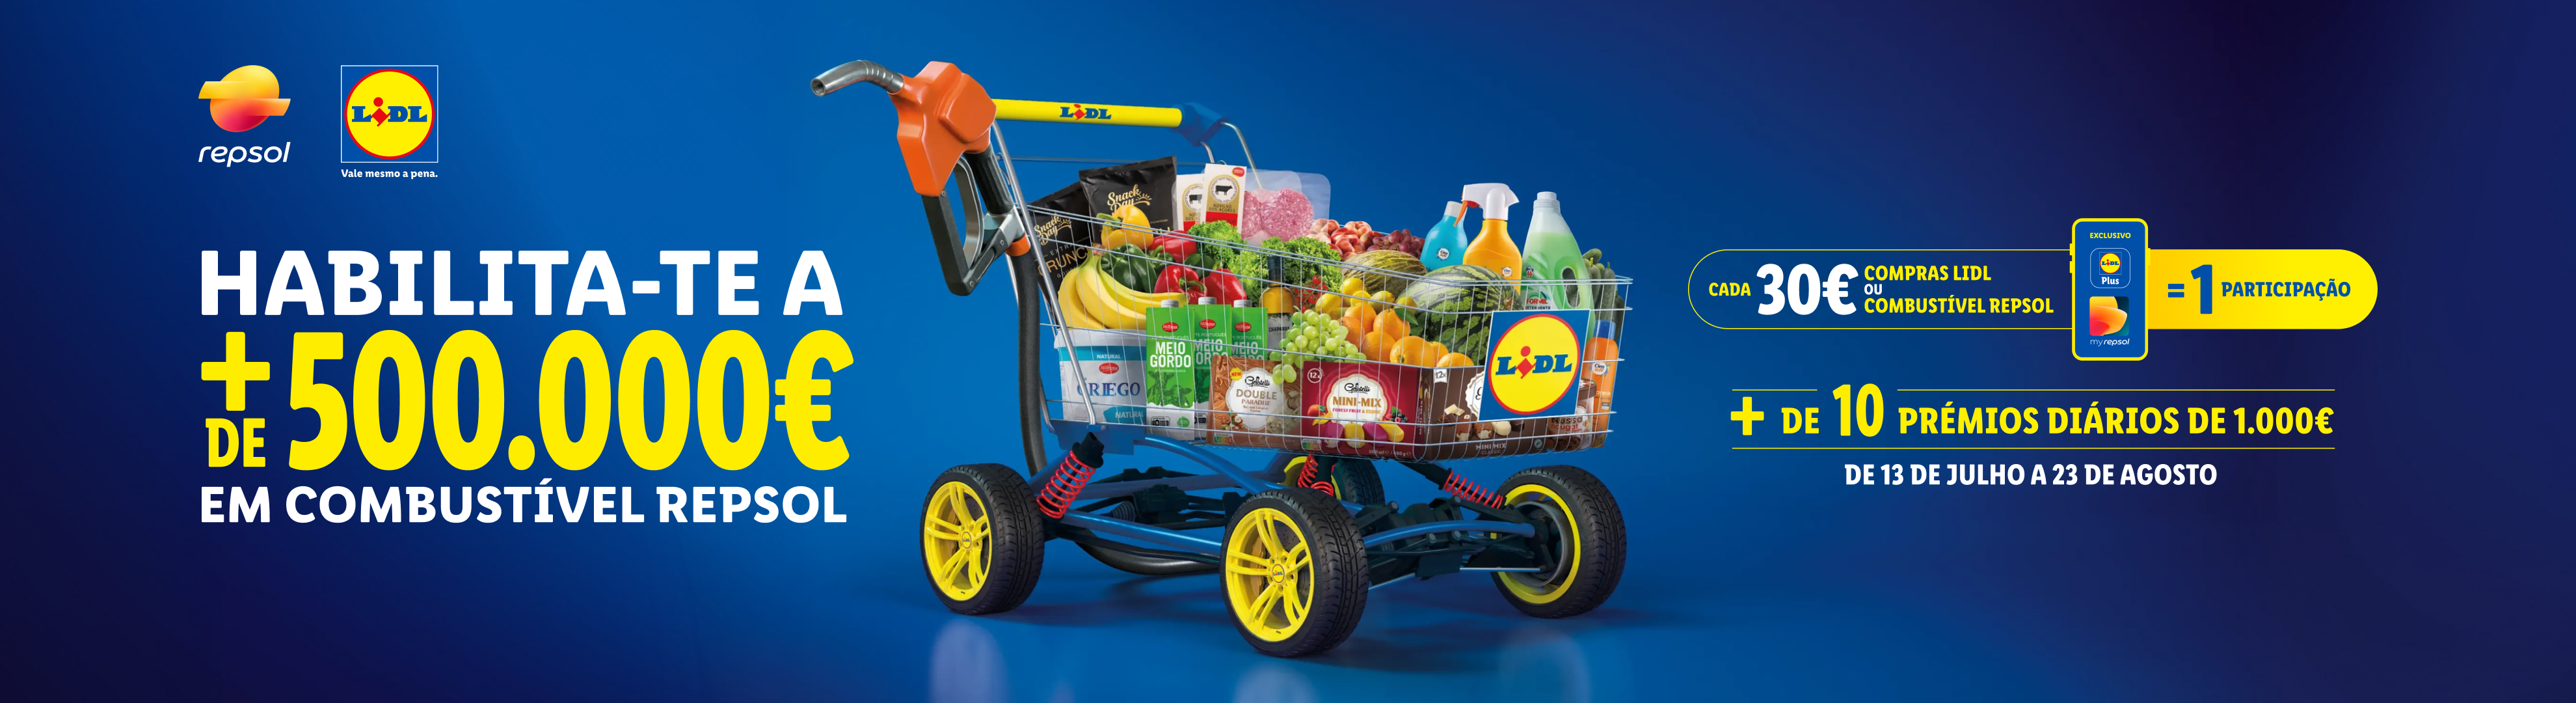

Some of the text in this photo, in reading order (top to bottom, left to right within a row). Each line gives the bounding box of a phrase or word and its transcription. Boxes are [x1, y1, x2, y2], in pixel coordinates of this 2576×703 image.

[198, 142, 291, 167] repsol
[342, 169, 363, 178] Vale
[411, 171, 438, 180] pena.
[1107, 184, 1141, 206] Snack
[1864, 265, 1992, 281] COMPRAS LIDL
[2101, 276, 2119, 285] Plus
[202, 251, 842, 315] HABILITA-TE A
[1709, 263, 1858, 316] CADA 30€
[1864, 284, 1883, 295] OU
[2191, 264, 2213, 314] 1
[2221, 278, 2351, 301] PARTICIPAÇÃO
[1864, 294, 2054, 314] COMBUSTÍVEL REPSOL
[1155, 342, 1186, 355] MEIO
[1149, 354, 1192, 368] GORDO
[1435, 370, 1447, 379] 12x
[202, 330, 854, 471] + DE 500.000€
[1236, 389, 1278, 400] DOUBLE
[1332, 396, 1382, 408] MINI-MIX
[1781, 407, 1819, 434] DE
[1832, 383, 1884, 437] 10
[1898, 401, 2039, 434] PRÉMIOS
[2047, 401, 2179, 434] DIÁRIOS
[2188, 407, 2226, 434] DE
[2233, 407, 2334, 434] 1.000€
[1551, 423, 1579, 432] nougat
[1845, 464, 2217, 486] DE 13 DE JULHO A 23 DE AGOSTO
[202, 478, 847, 523] EM COMBUSTÍVEL REPSOL
